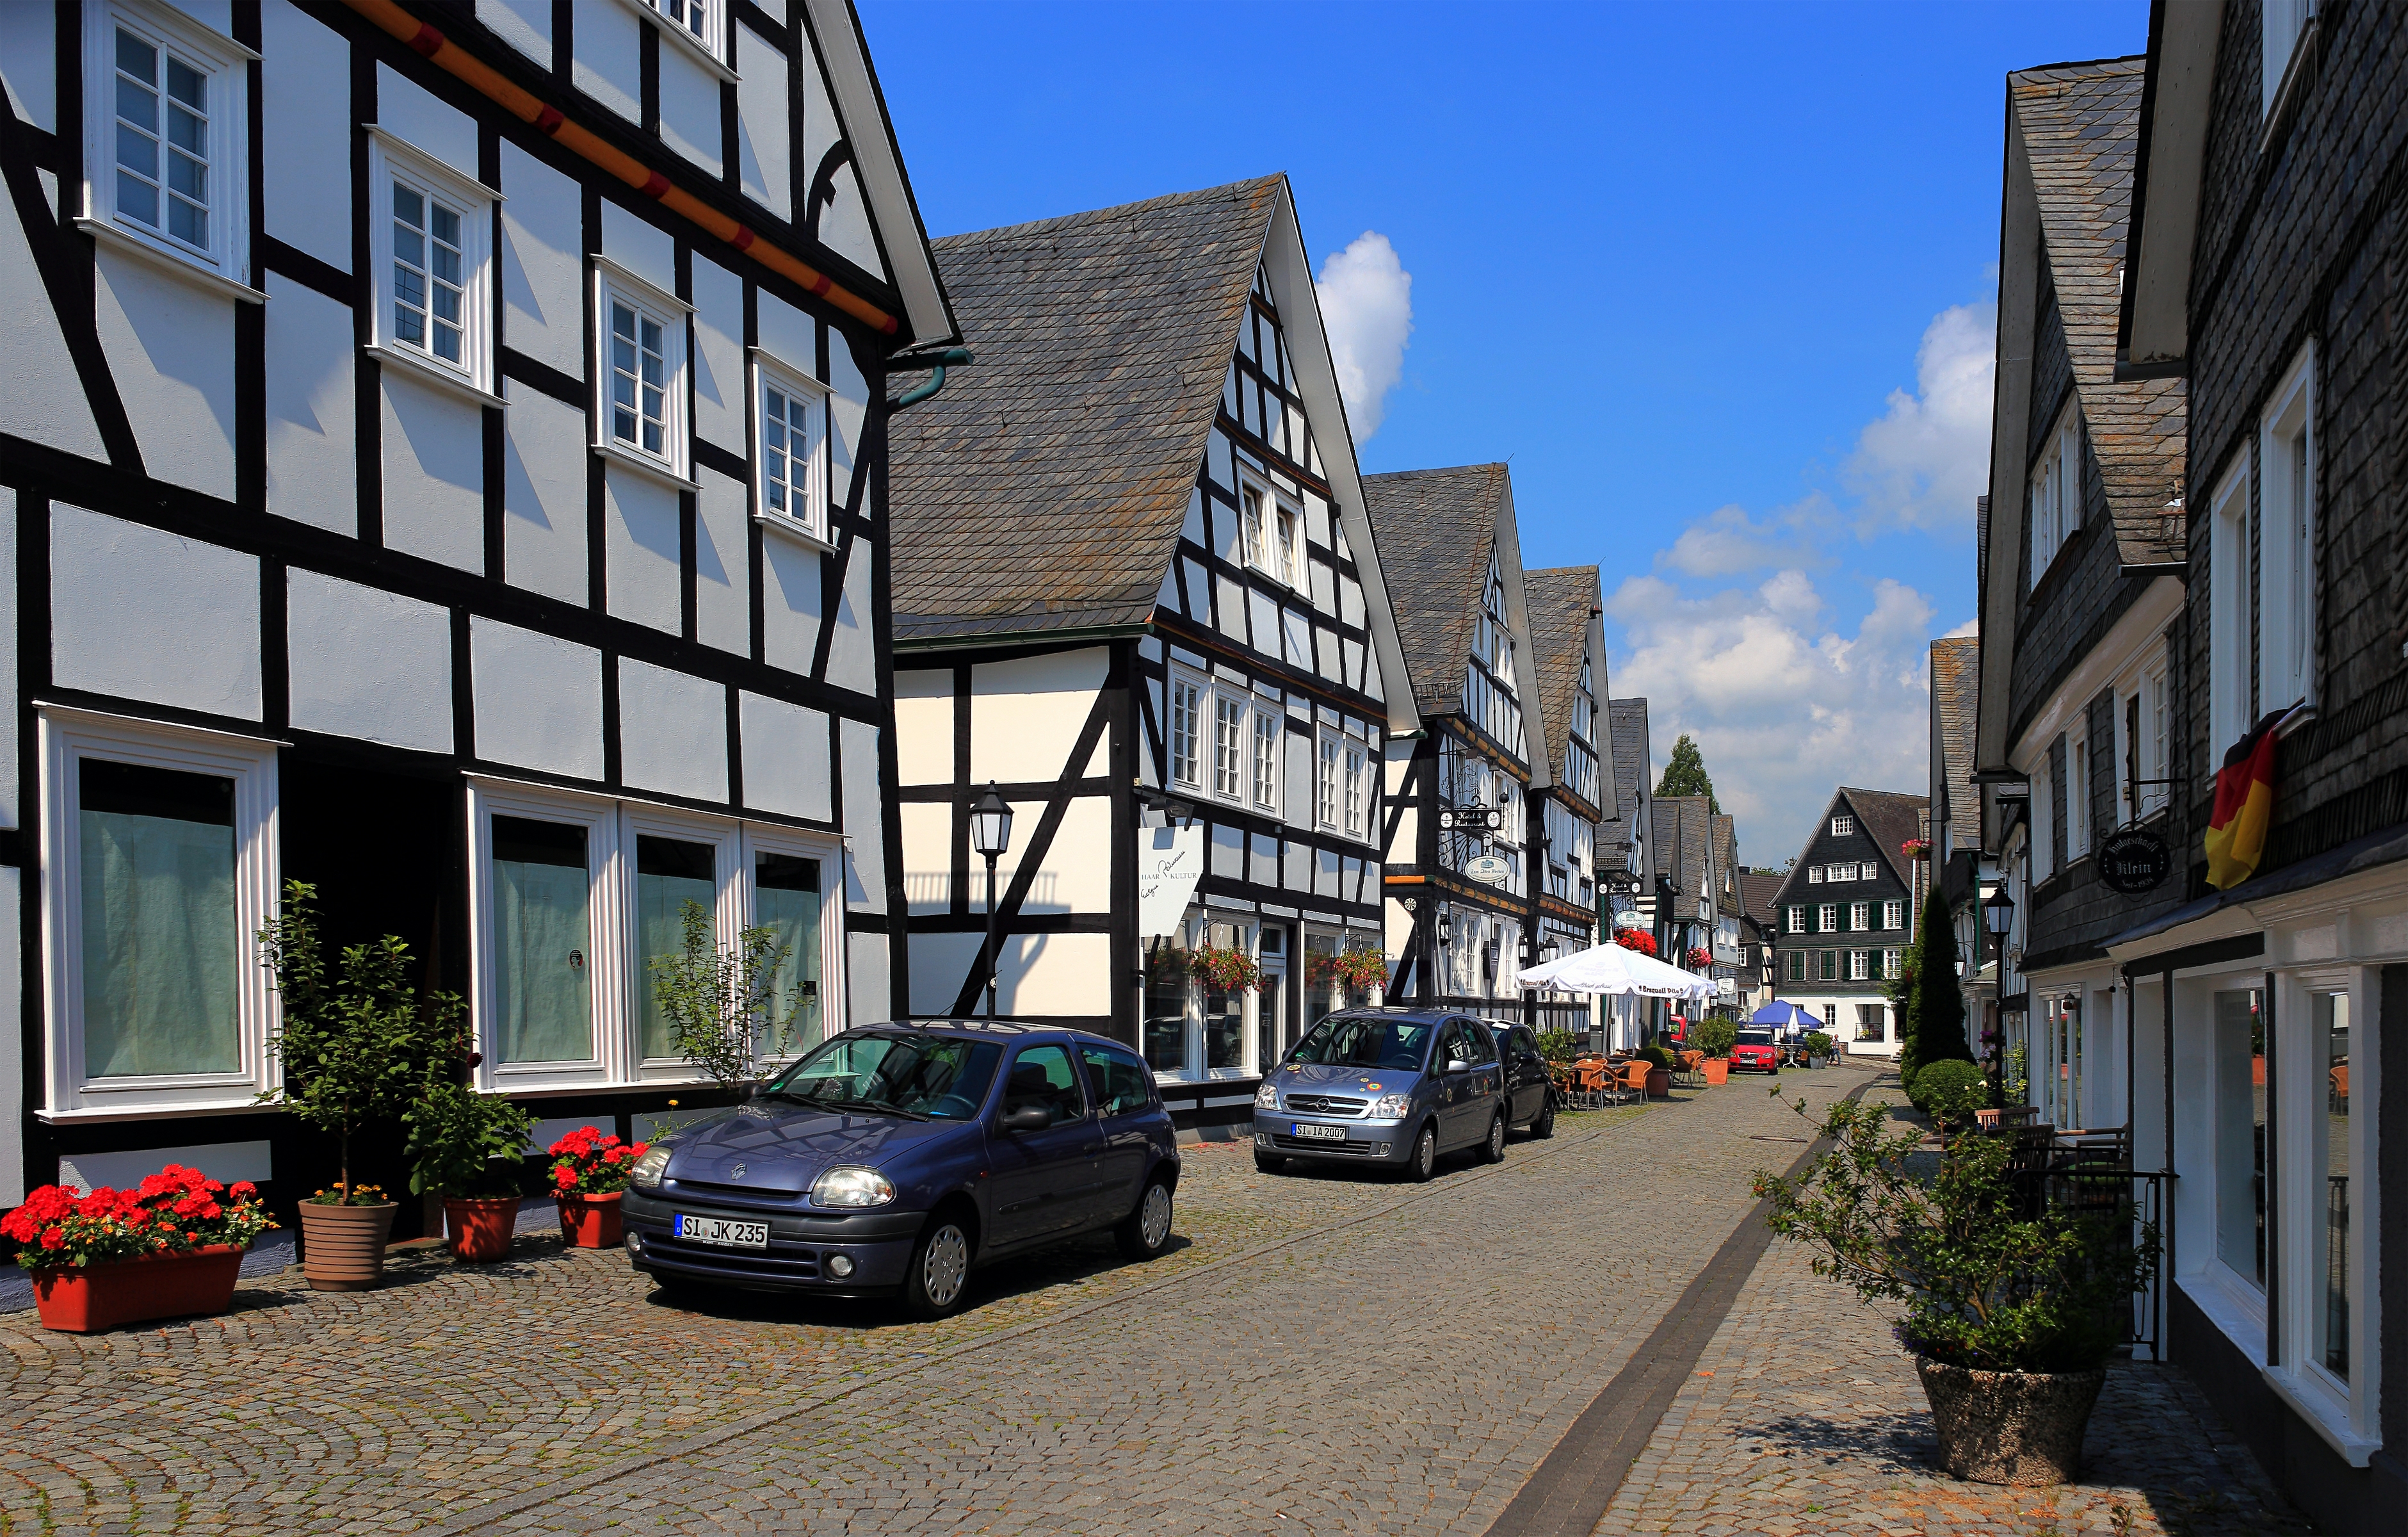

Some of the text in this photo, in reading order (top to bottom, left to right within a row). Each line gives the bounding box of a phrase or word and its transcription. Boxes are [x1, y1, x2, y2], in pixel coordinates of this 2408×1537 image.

[2115, 861, 2151, 875] Klein
[1297, 1125, 1345, 1137] SI IA 2007
[683, 1217, 700, 1236] SI
[711, 1221, 731, 1240] JK
[734, 1224, 766, 1243] 235
